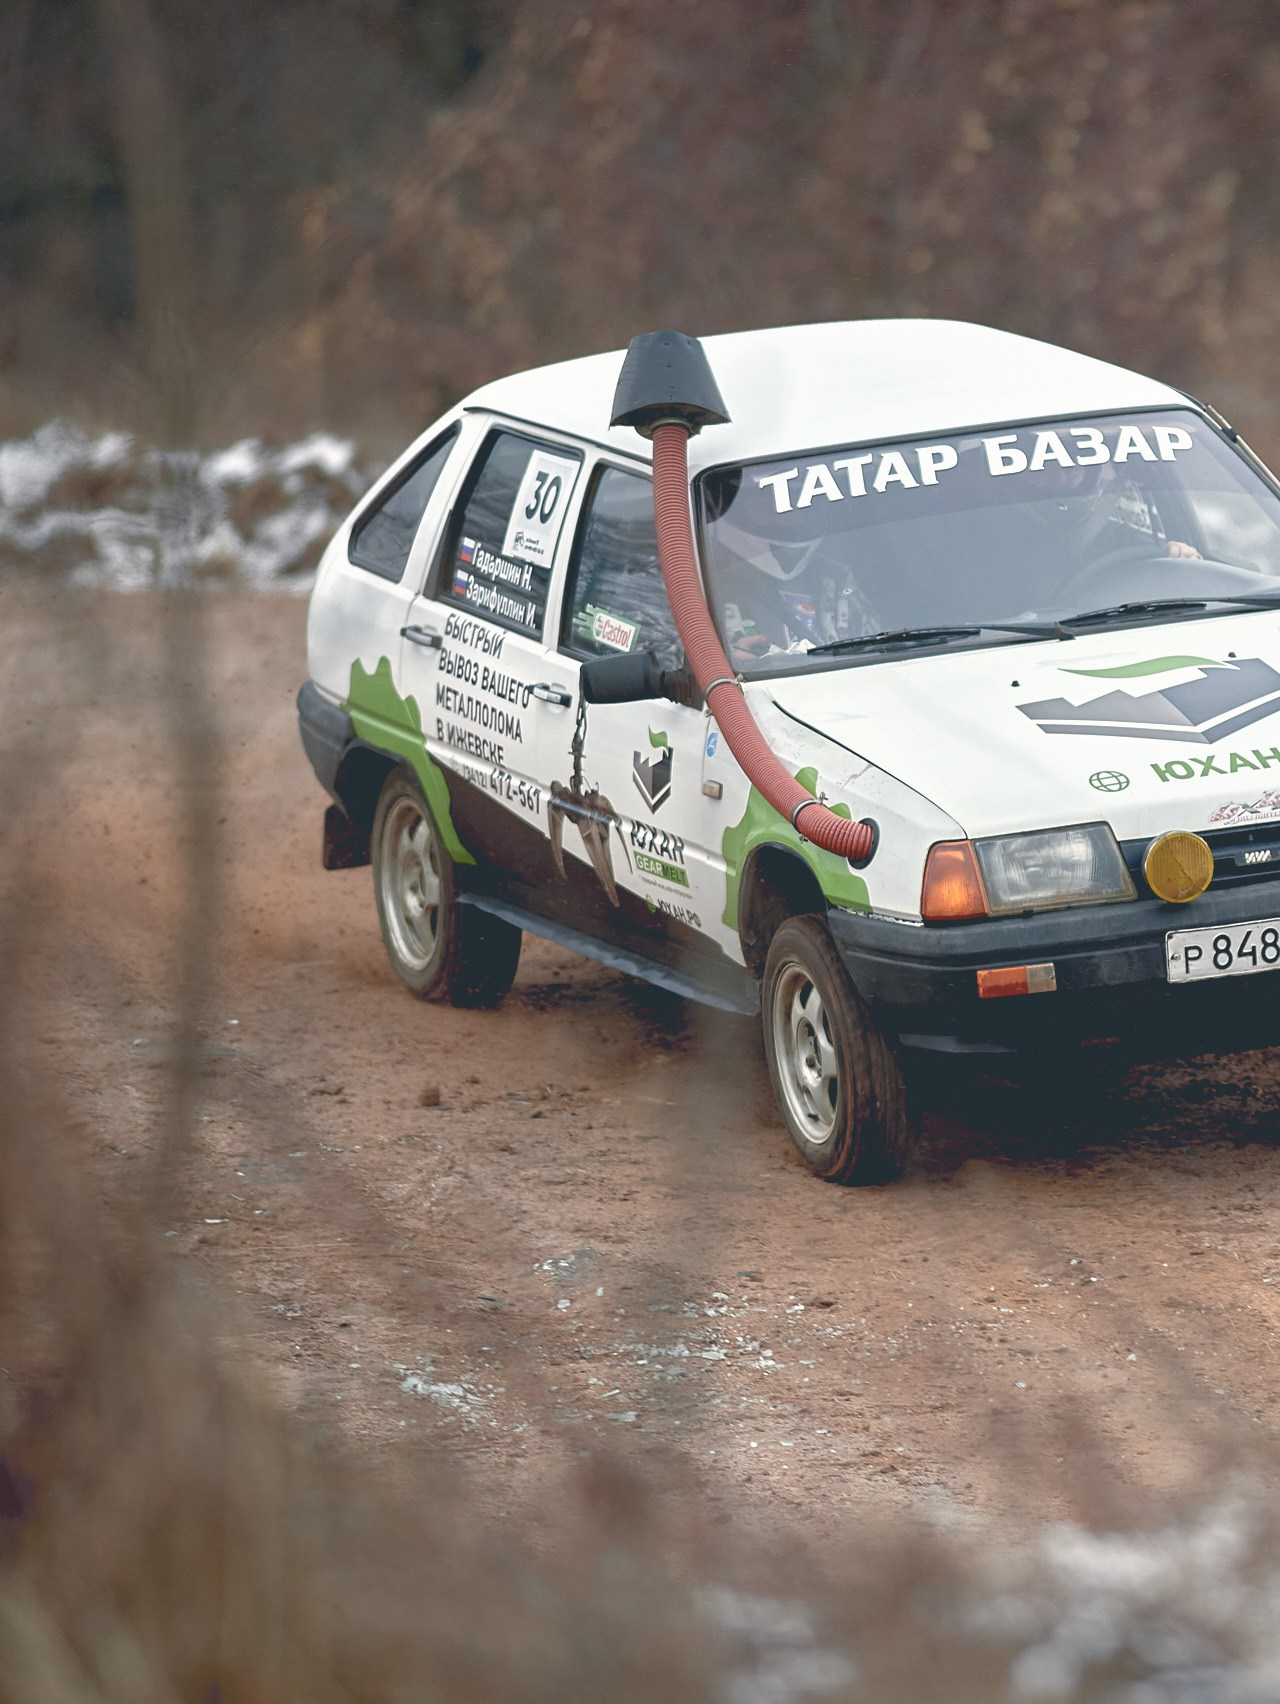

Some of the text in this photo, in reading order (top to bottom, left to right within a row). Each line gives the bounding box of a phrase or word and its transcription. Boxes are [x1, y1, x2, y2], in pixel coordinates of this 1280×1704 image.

[759, 425, 1194, 514] ТАТАР БАЗАР
[525, 470, 562, 525] 30
[471, 542, 534, 592] Гадаршин Н.
[466, 575, 536, 630] Зарифуллин И.
[445, 613, 508, 659] БЫСТРЫЙ
[602, 619, 632, 648] Castrol
[438, 647, 530, 709] ВЫВОЗ ВАШЕГО
[436, 682, 523, 744] МЕТАЛЛОЛОМА
[436, 717, 506, 769] В ИЖЕВСКЕ
